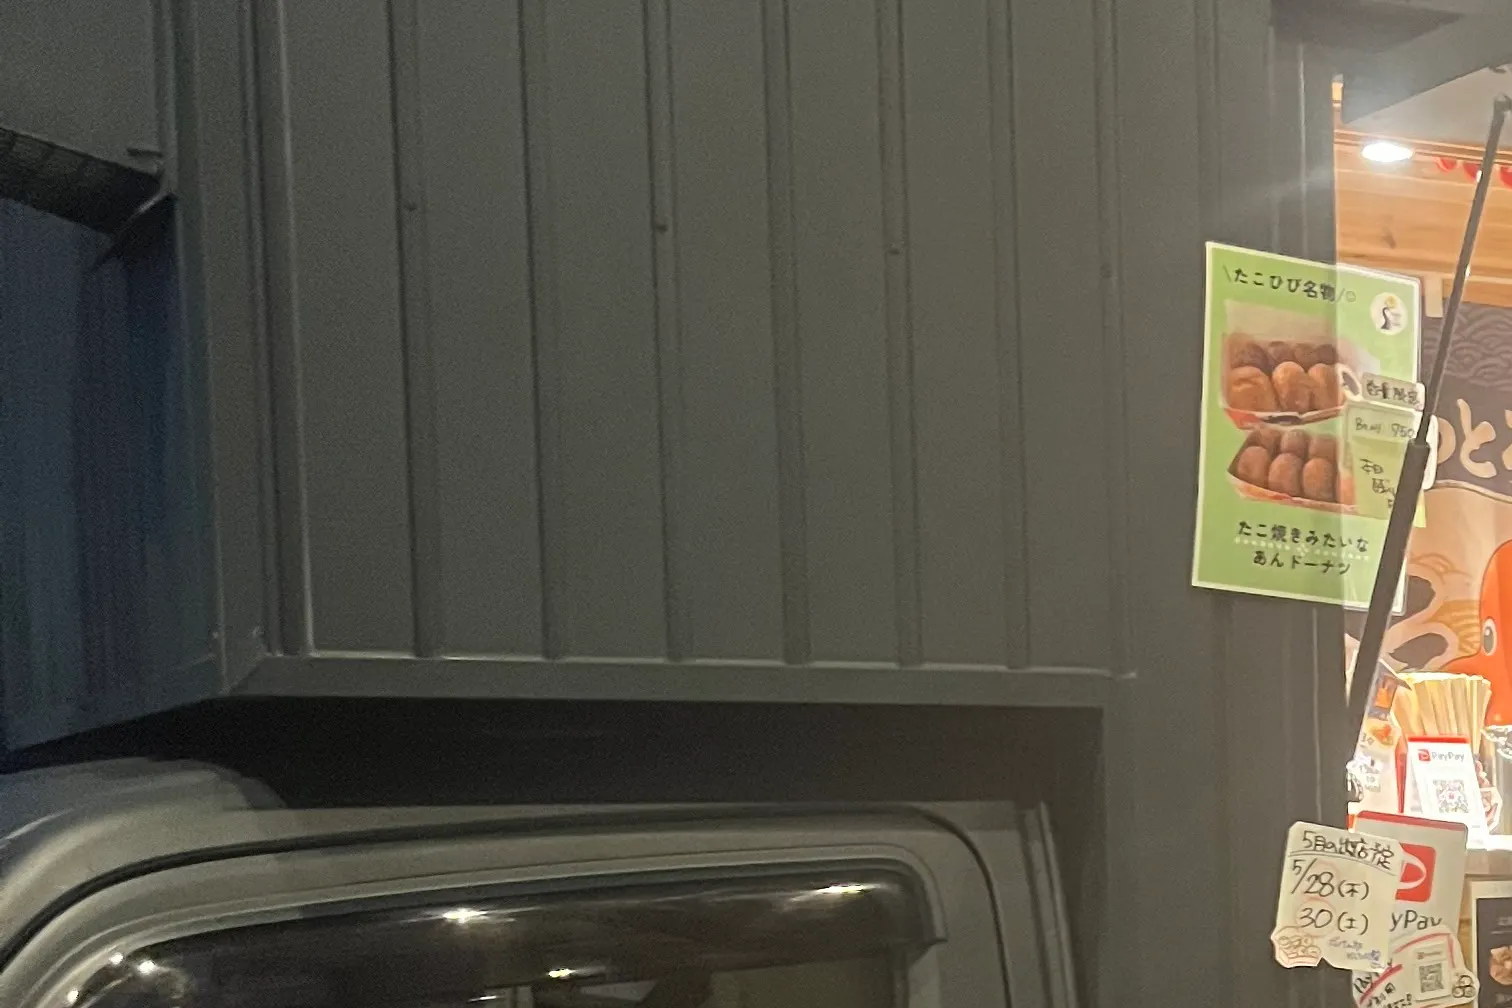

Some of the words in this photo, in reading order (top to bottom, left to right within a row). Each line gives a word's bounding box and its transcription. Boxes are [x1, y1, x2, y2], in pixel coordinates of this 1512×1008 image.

[1238, 521, 1368, 552] たこ焼きみたいな
[1253, 550, 1350, 575] あんドーナツ
[1431, 751, 1465, 763] PayPay
[1390, 909, 1443, 931] yPay
